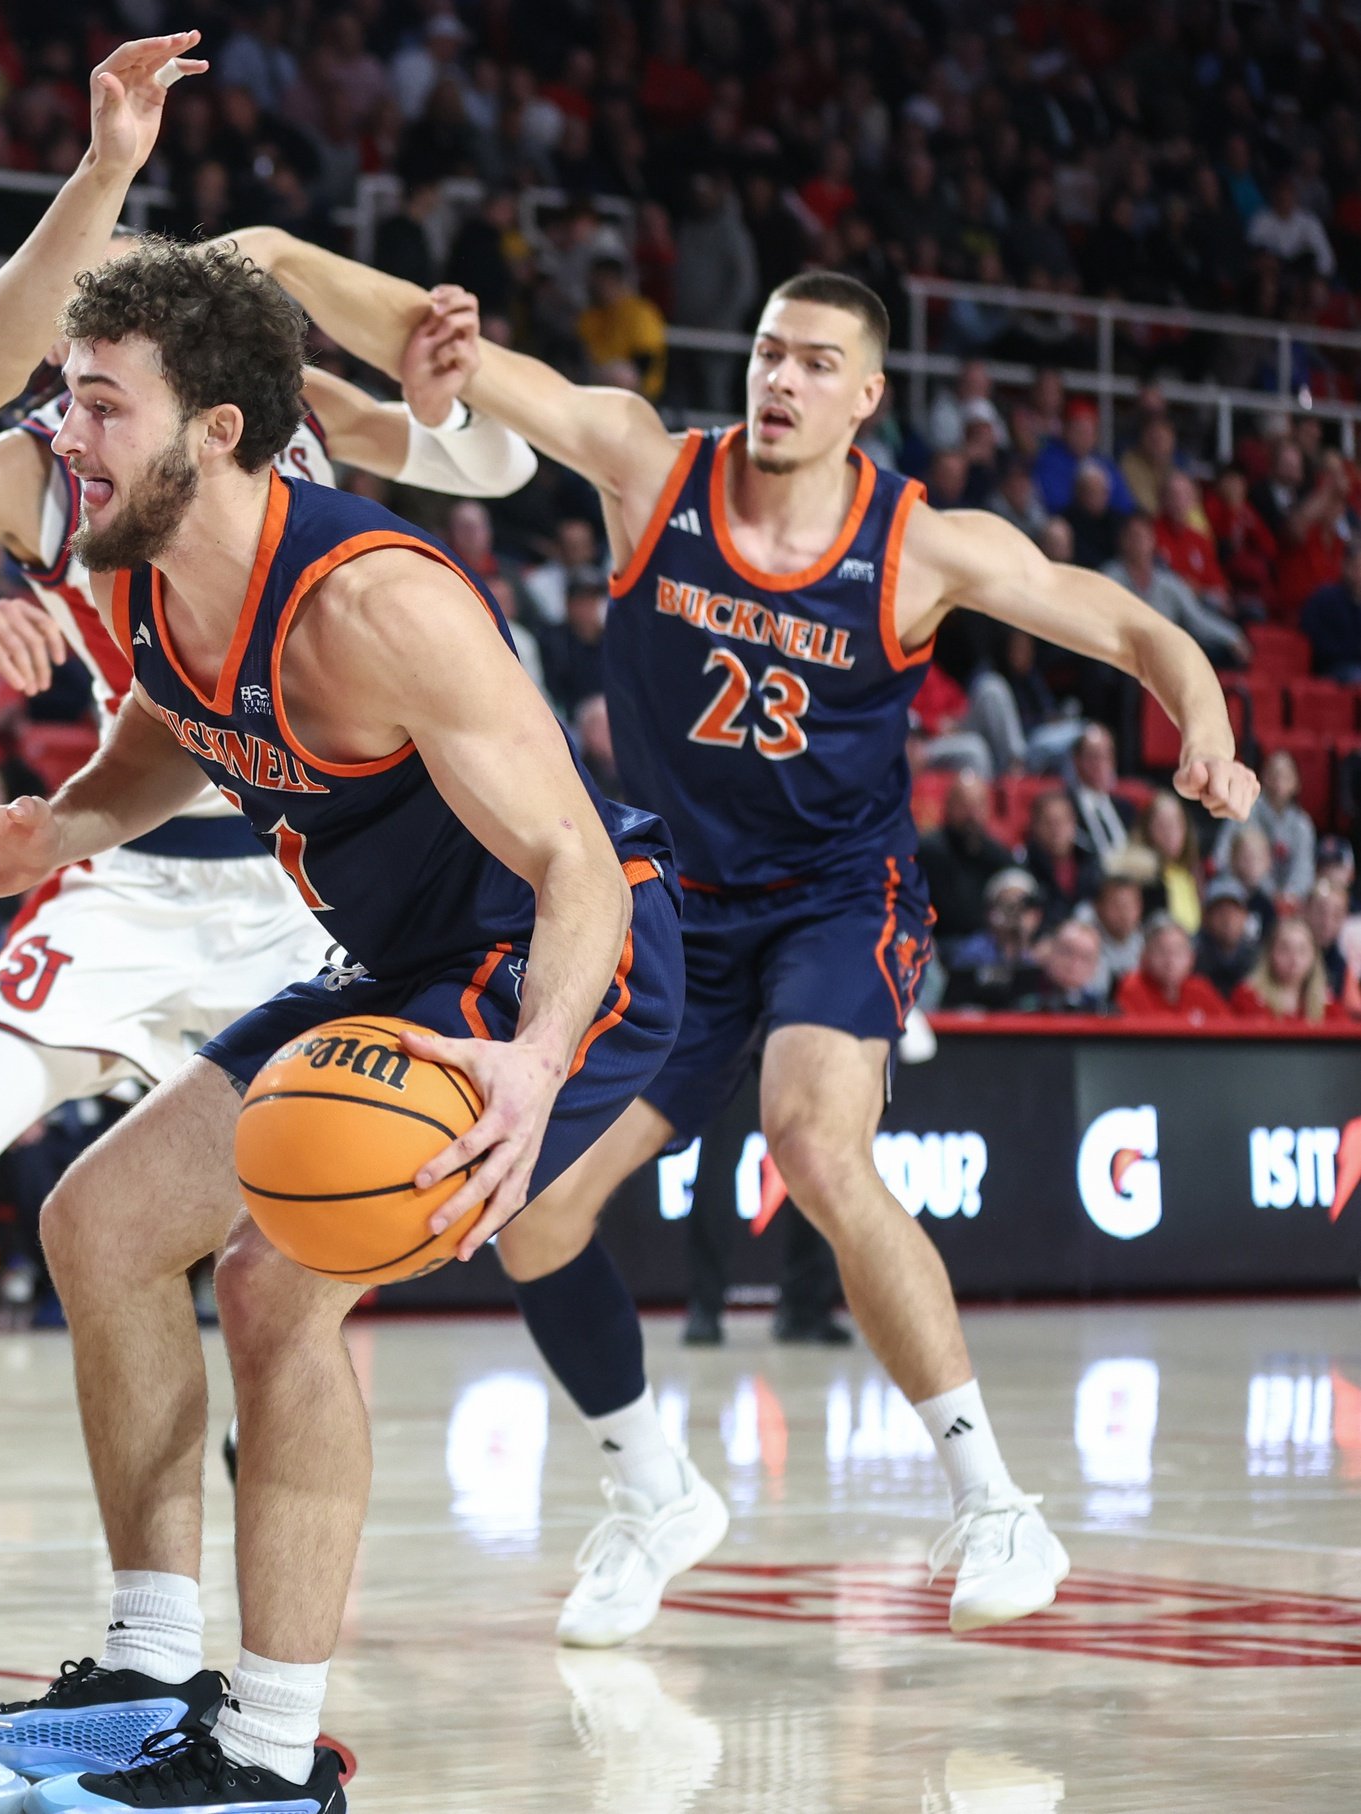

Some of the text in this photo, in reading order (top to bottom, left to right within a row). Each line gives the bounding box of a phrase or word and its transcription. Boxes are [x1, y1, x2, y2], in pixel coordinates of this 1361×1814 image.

[656, 575, 855, 670] BUCKNELL
[157, 703, 330, 793] UCKNELL
[687, 647, 810, 760] 23
[1077, 1104, 1163, 1240] G
